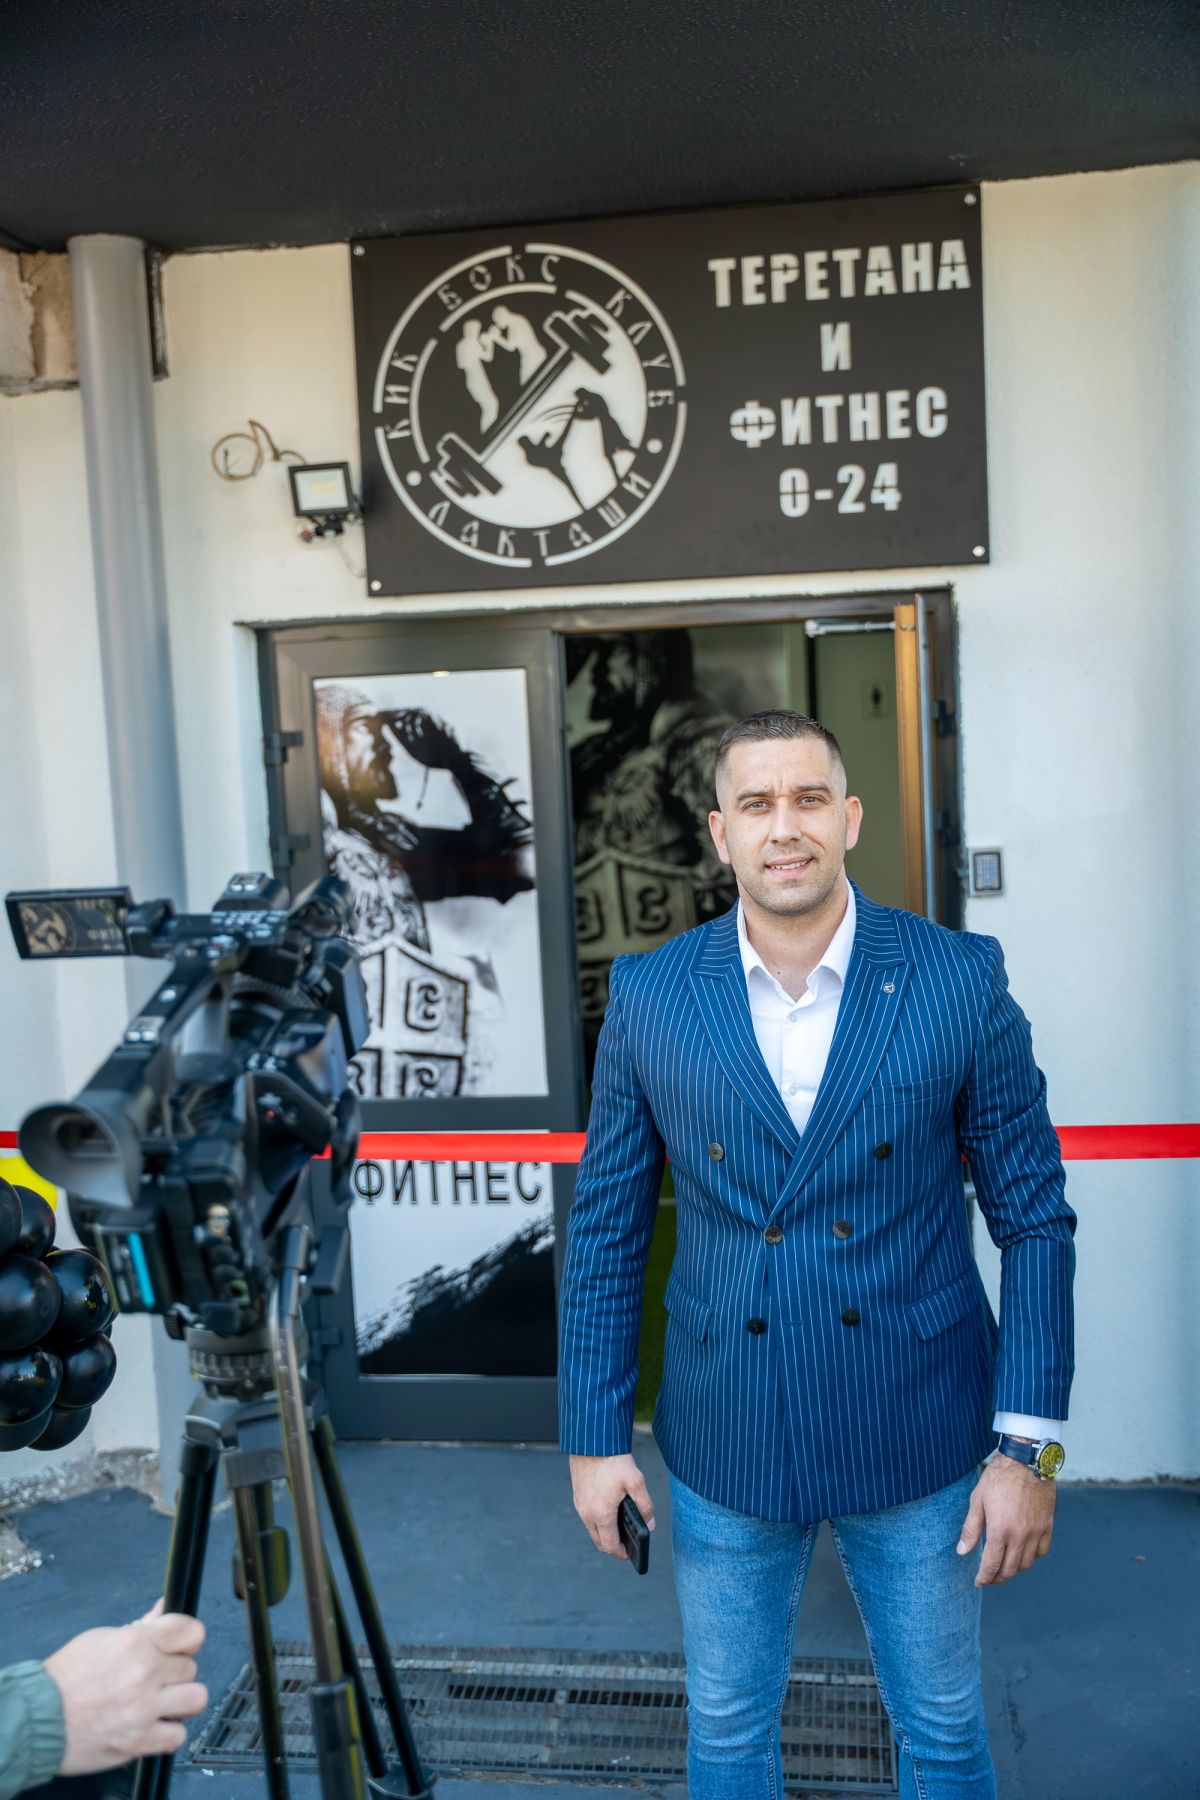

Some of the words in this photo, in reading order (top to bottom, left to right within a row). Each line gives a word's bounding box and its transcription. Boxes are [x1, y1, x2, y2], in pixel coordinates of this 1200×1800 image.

[708, 239, 972, 308] ТЕРЕТАНА
[383, 352, 419, 441] КИК
[436, 253, 561, 312] БОКС
[605, 287, 675, 408] КЛУБ
[820, 321, 852, 372] И
[729, 386, 949, 449] ФИТНЕС
[428, 471, 652, 558] ЛАКТАШИ
[779, 461, 902, 518] 0-24
[353, 1160, 545, 1206] ФИТНЕС
